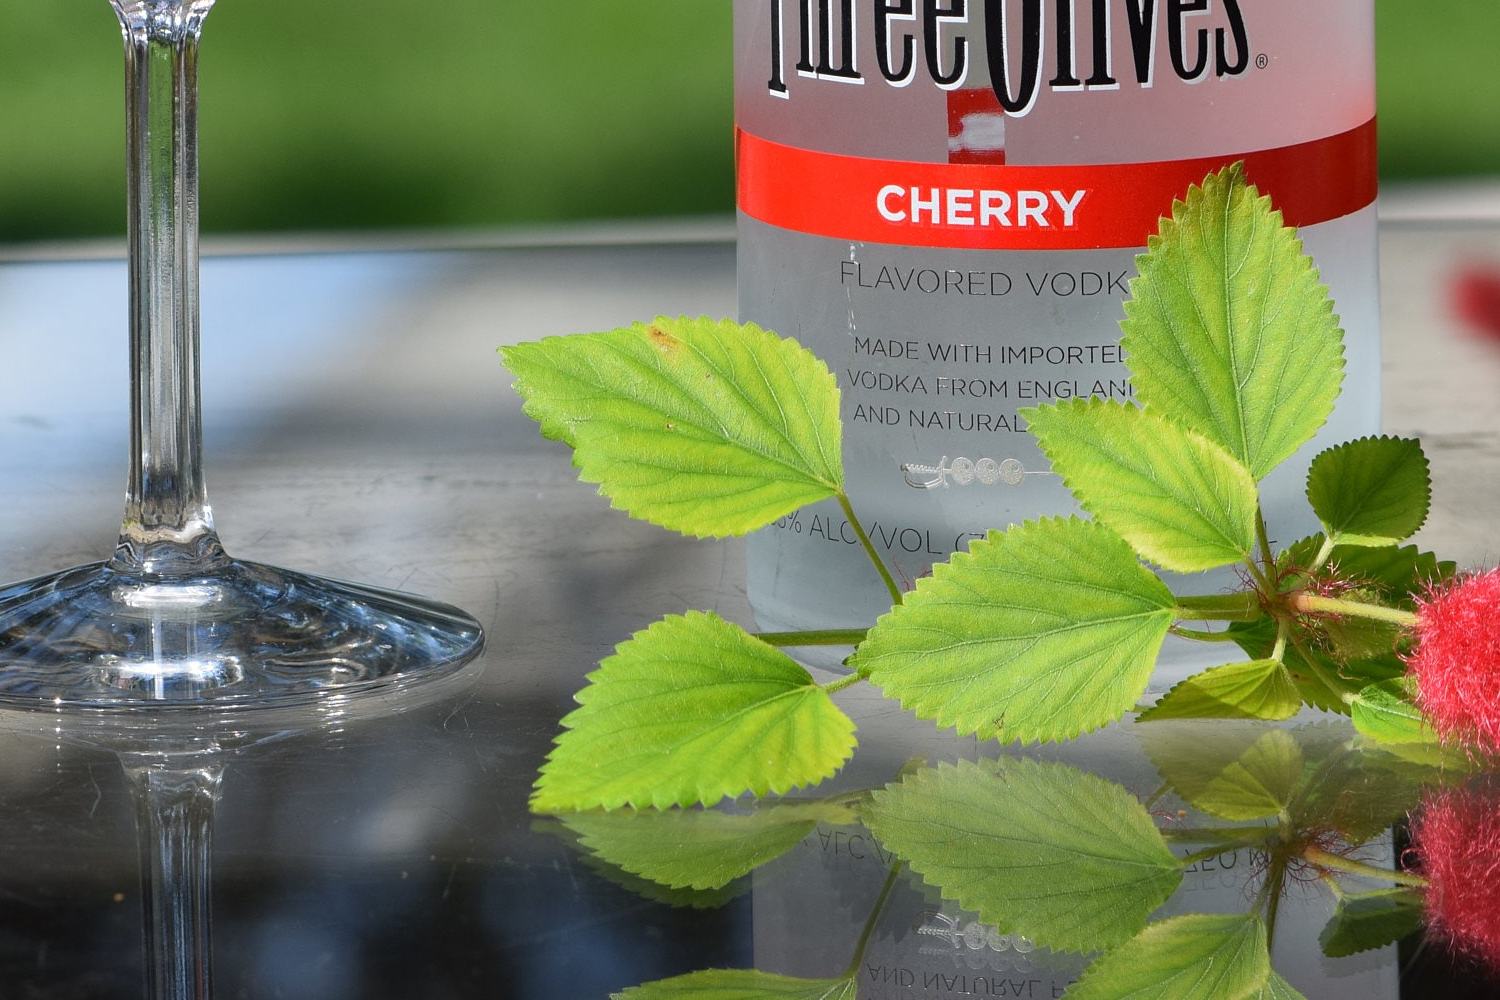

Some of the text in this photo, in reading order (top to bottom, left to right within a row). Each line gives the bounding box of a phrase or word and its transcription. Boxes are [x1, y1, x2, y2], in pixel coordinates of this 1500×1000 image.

[877, 184, 1087, 227] CHERRY
[840, 261, 1136, 296] FLAVORED VODK
[854, 336, 919, 360] MADE
[927, 342, 991, 364] WITH
[847, 368, 928, 395] VODKA
[937, 377, 1008, 398] FROM
[853, 403, 1027, 433] AND NATURAL
